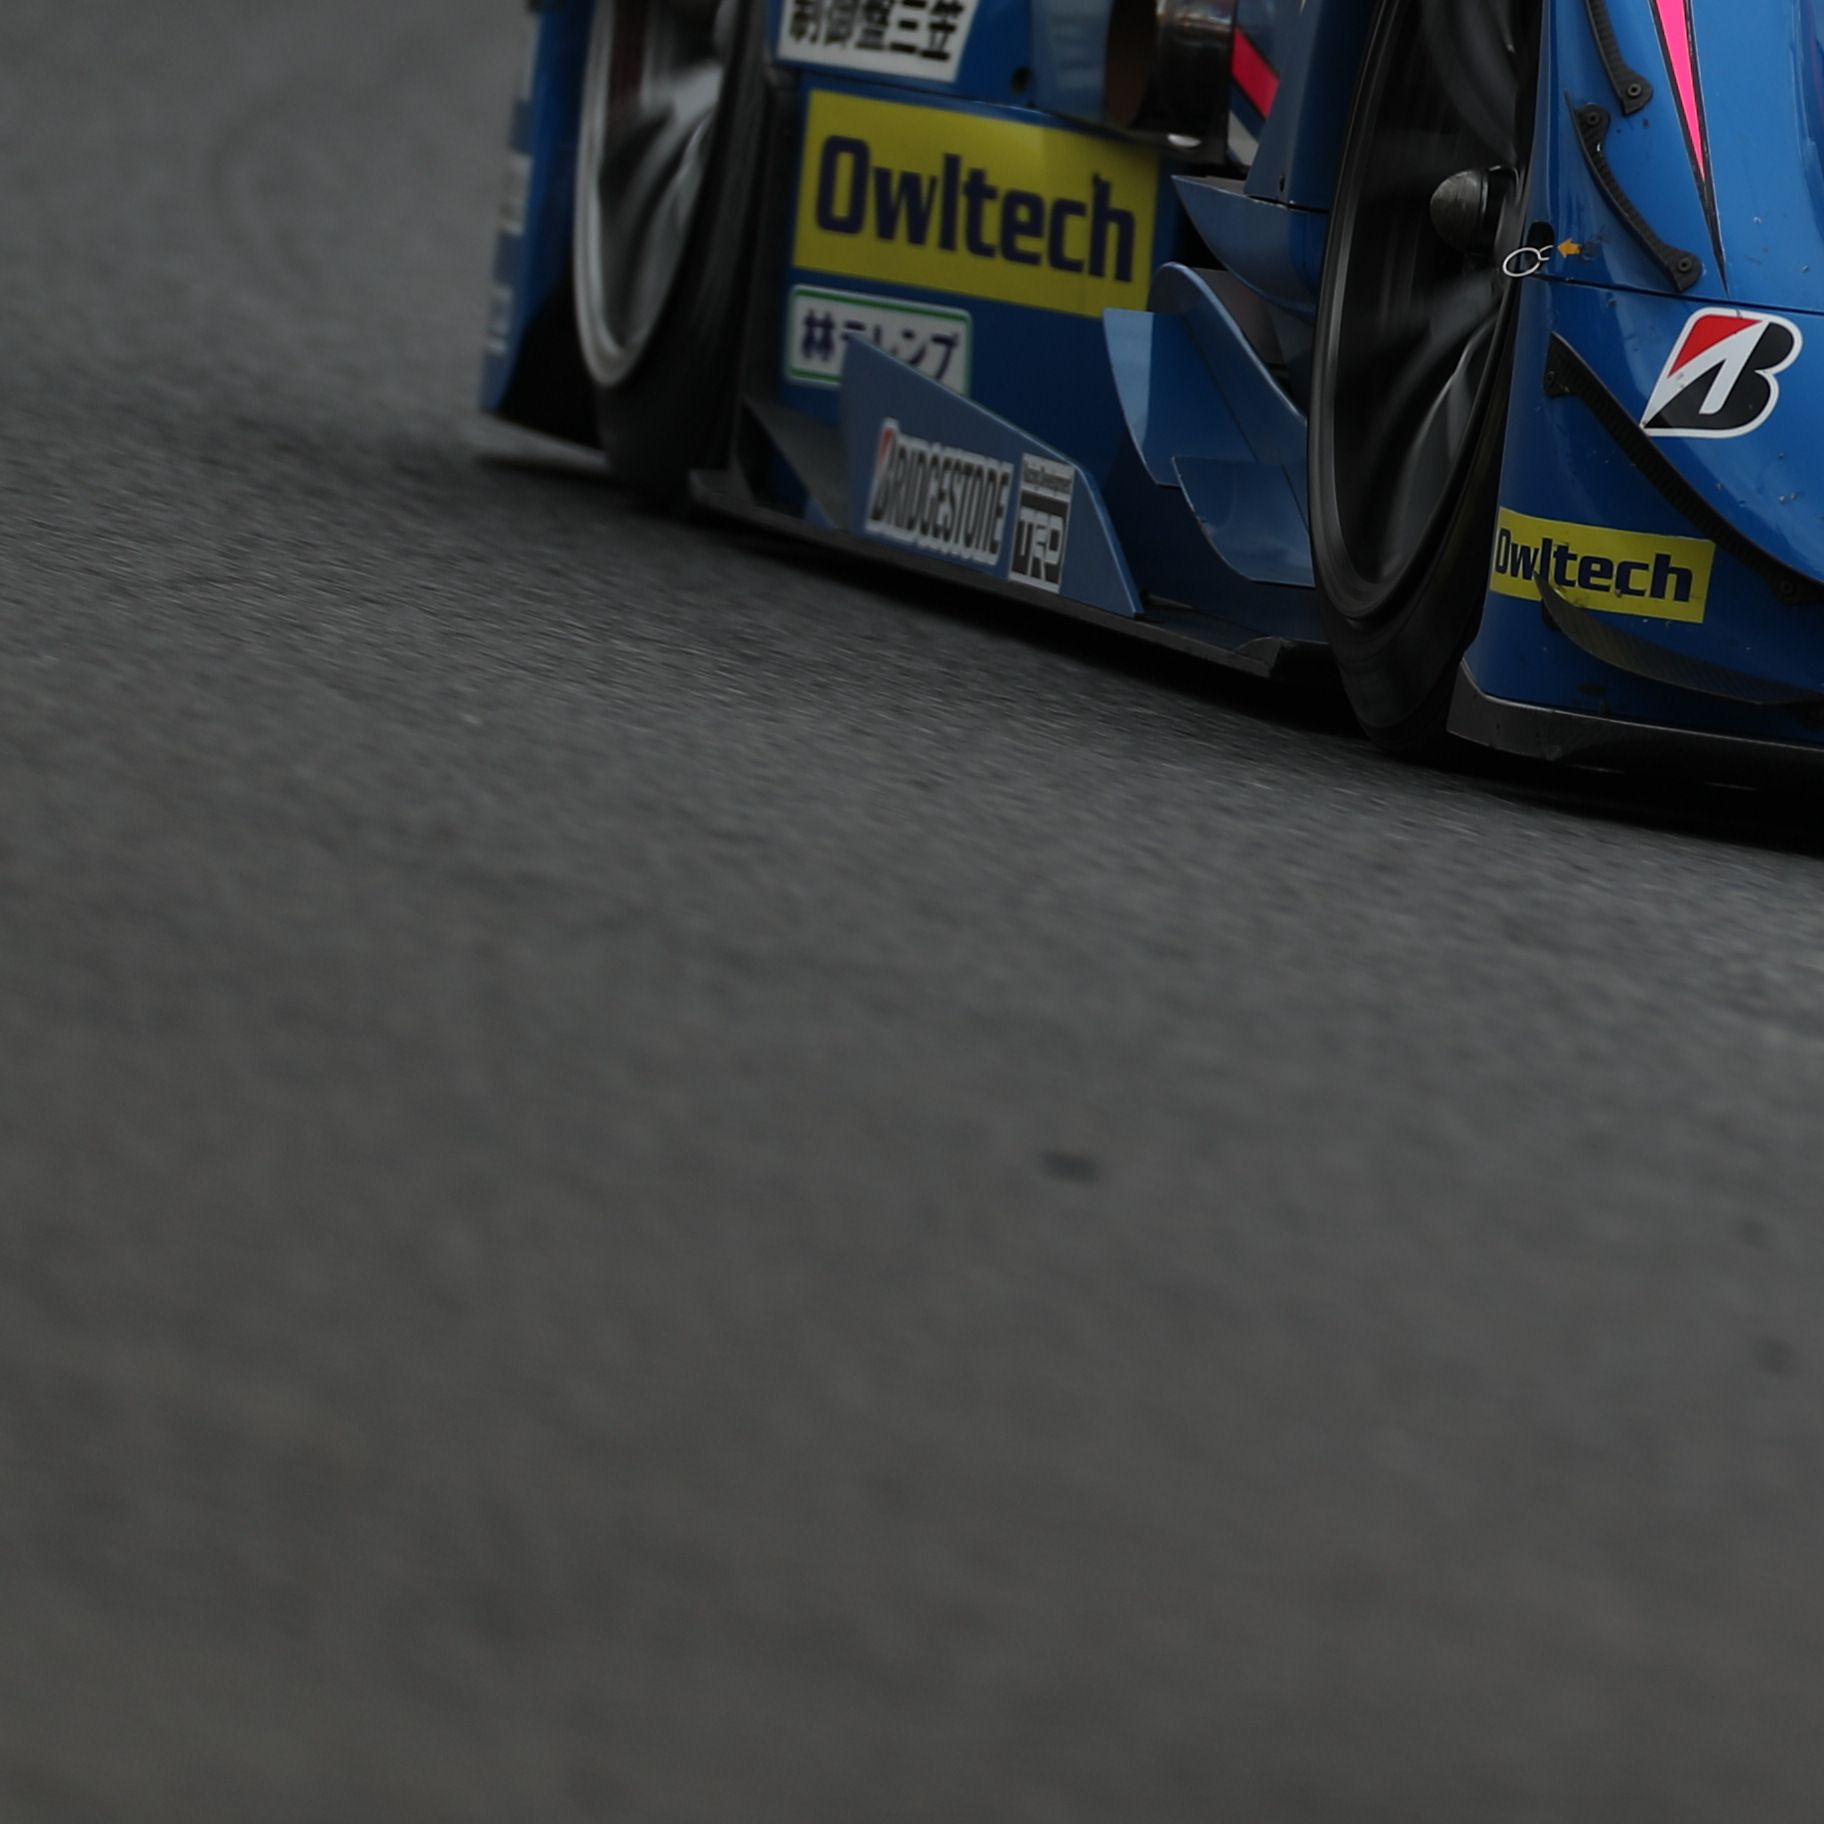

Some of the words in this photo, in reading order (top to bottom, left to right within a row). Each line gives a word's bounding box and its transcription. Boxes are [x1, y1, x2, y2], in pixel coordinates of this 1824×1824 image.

[815, 134, 1138, 283] Owltech
[868, 427, 1011, 556] BRIDGESTONE
[1494, 526, 1694, 603] Owltech
